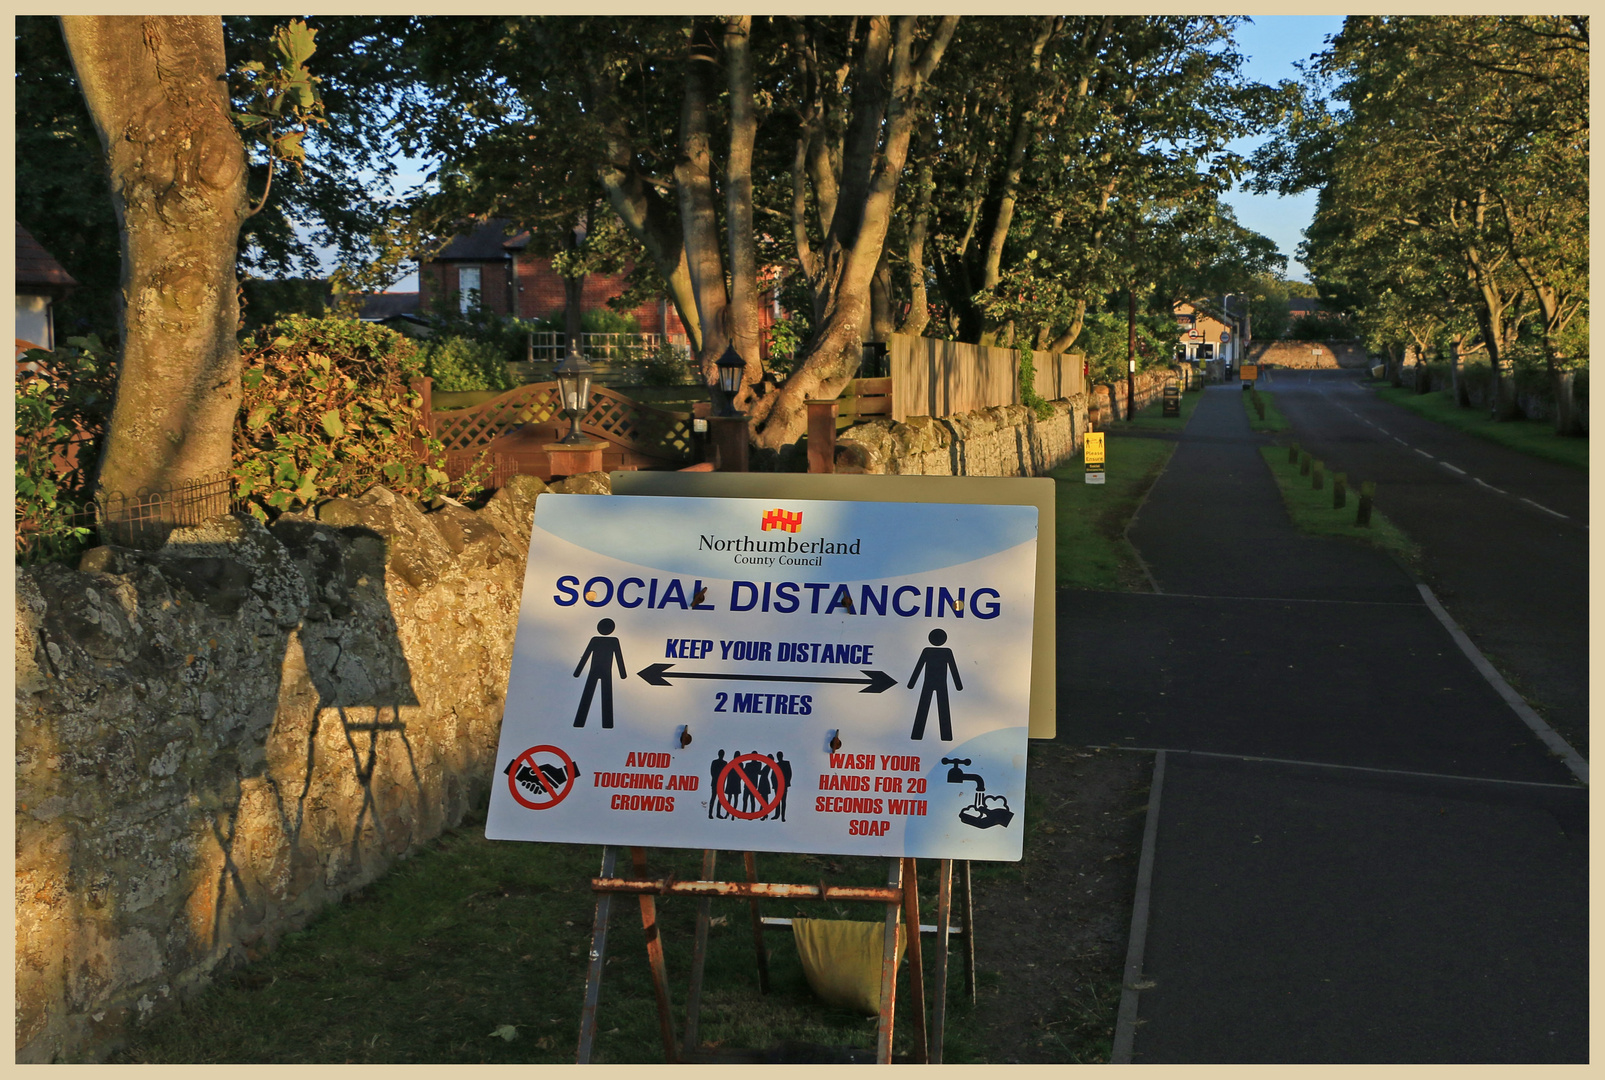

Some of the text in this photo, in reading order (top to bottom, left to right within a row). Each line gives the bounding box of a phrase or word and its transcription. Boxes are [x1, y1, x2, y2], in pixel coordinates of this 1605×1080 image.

[699, 535, 861, 555] Northumberland
[734, 554, 822, 567] County Council
[553, 575, 1001, 620] SOCIAL DISTANCING
[665, 639, 873, 665] KEEP YOUR DISTANCE
[714, 693, 813, 715] 2 METRES
[625, 751, 671, 769] AVOID
[829, 753, 921, 772] WASH YOUR
[593, 772, 699, 792] TOUCHING AND
[819, 775, 927, 794] HANDS FOR 20
[611, 794, 675, 813] CROWDS
[815, 796, 928, 816] SECONDS WITH
[848, 819, 890, 837] SOAP
